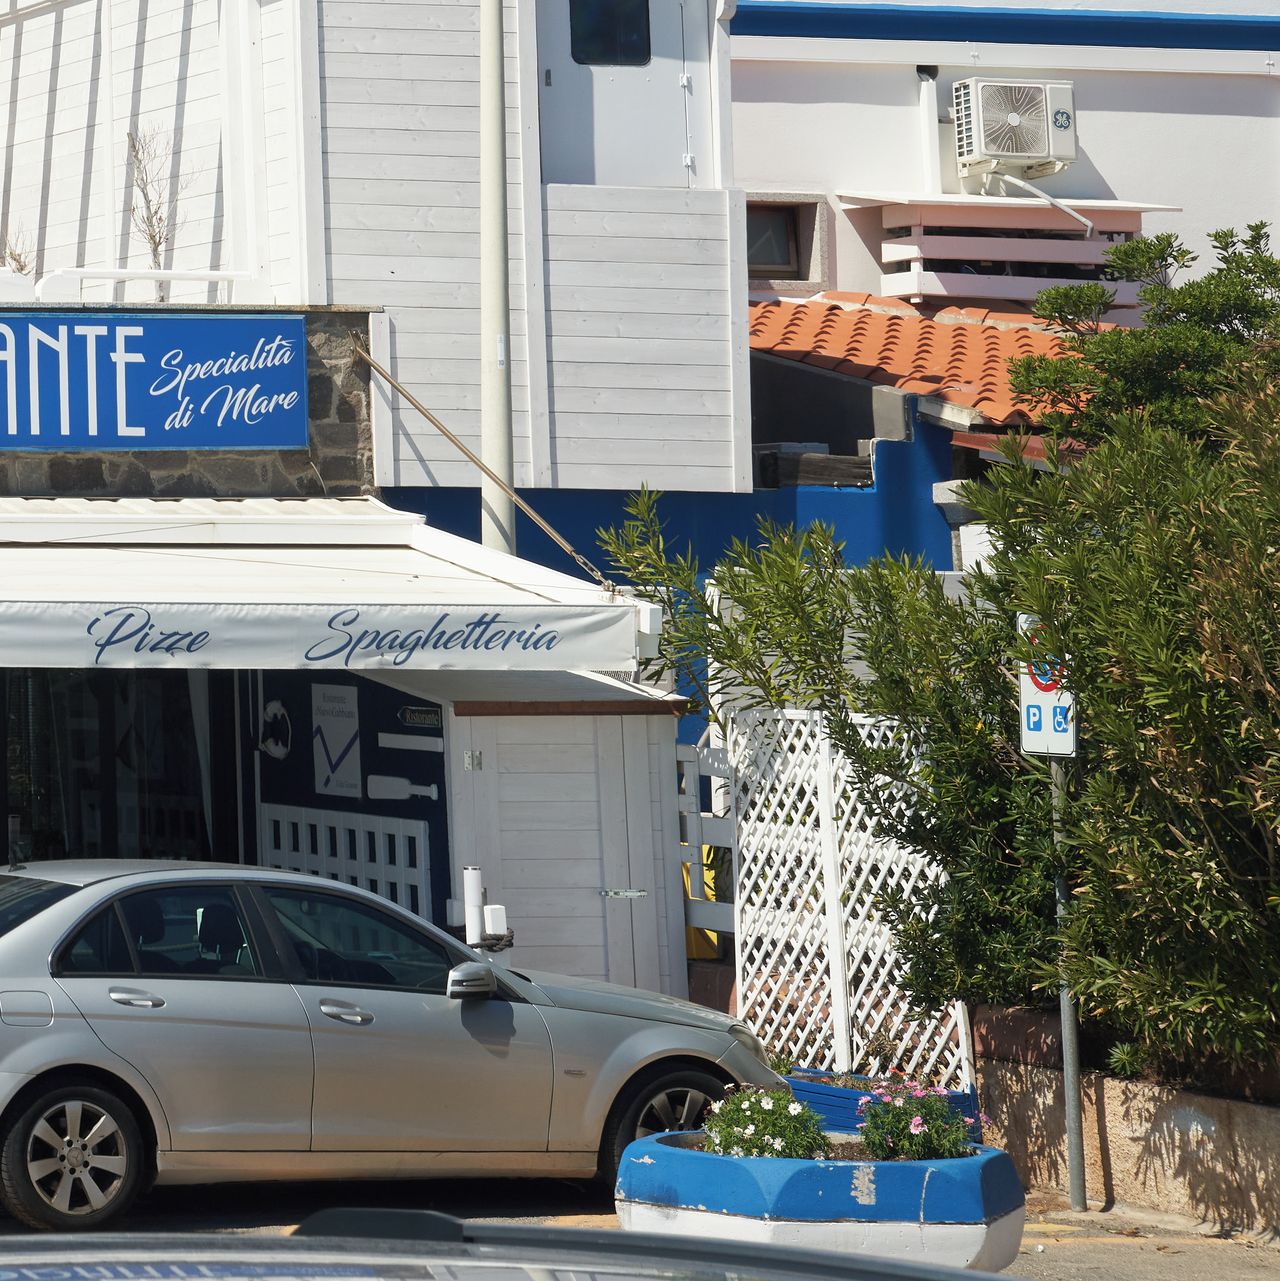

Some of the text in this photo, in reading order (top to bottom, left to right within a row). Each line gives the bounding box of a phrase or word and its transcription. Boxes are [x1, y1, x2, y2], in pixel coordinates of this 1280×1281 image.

[149, 335, 296, 401] Specialità
[164, 383, 300, 432] di Mare
[86, 606, 211, 665] Pizze
[304, 608, 563, 667] Spaghetteria
[406, 710, 439, 726] Ristorante
[1029, 707, 1040, 729] P
